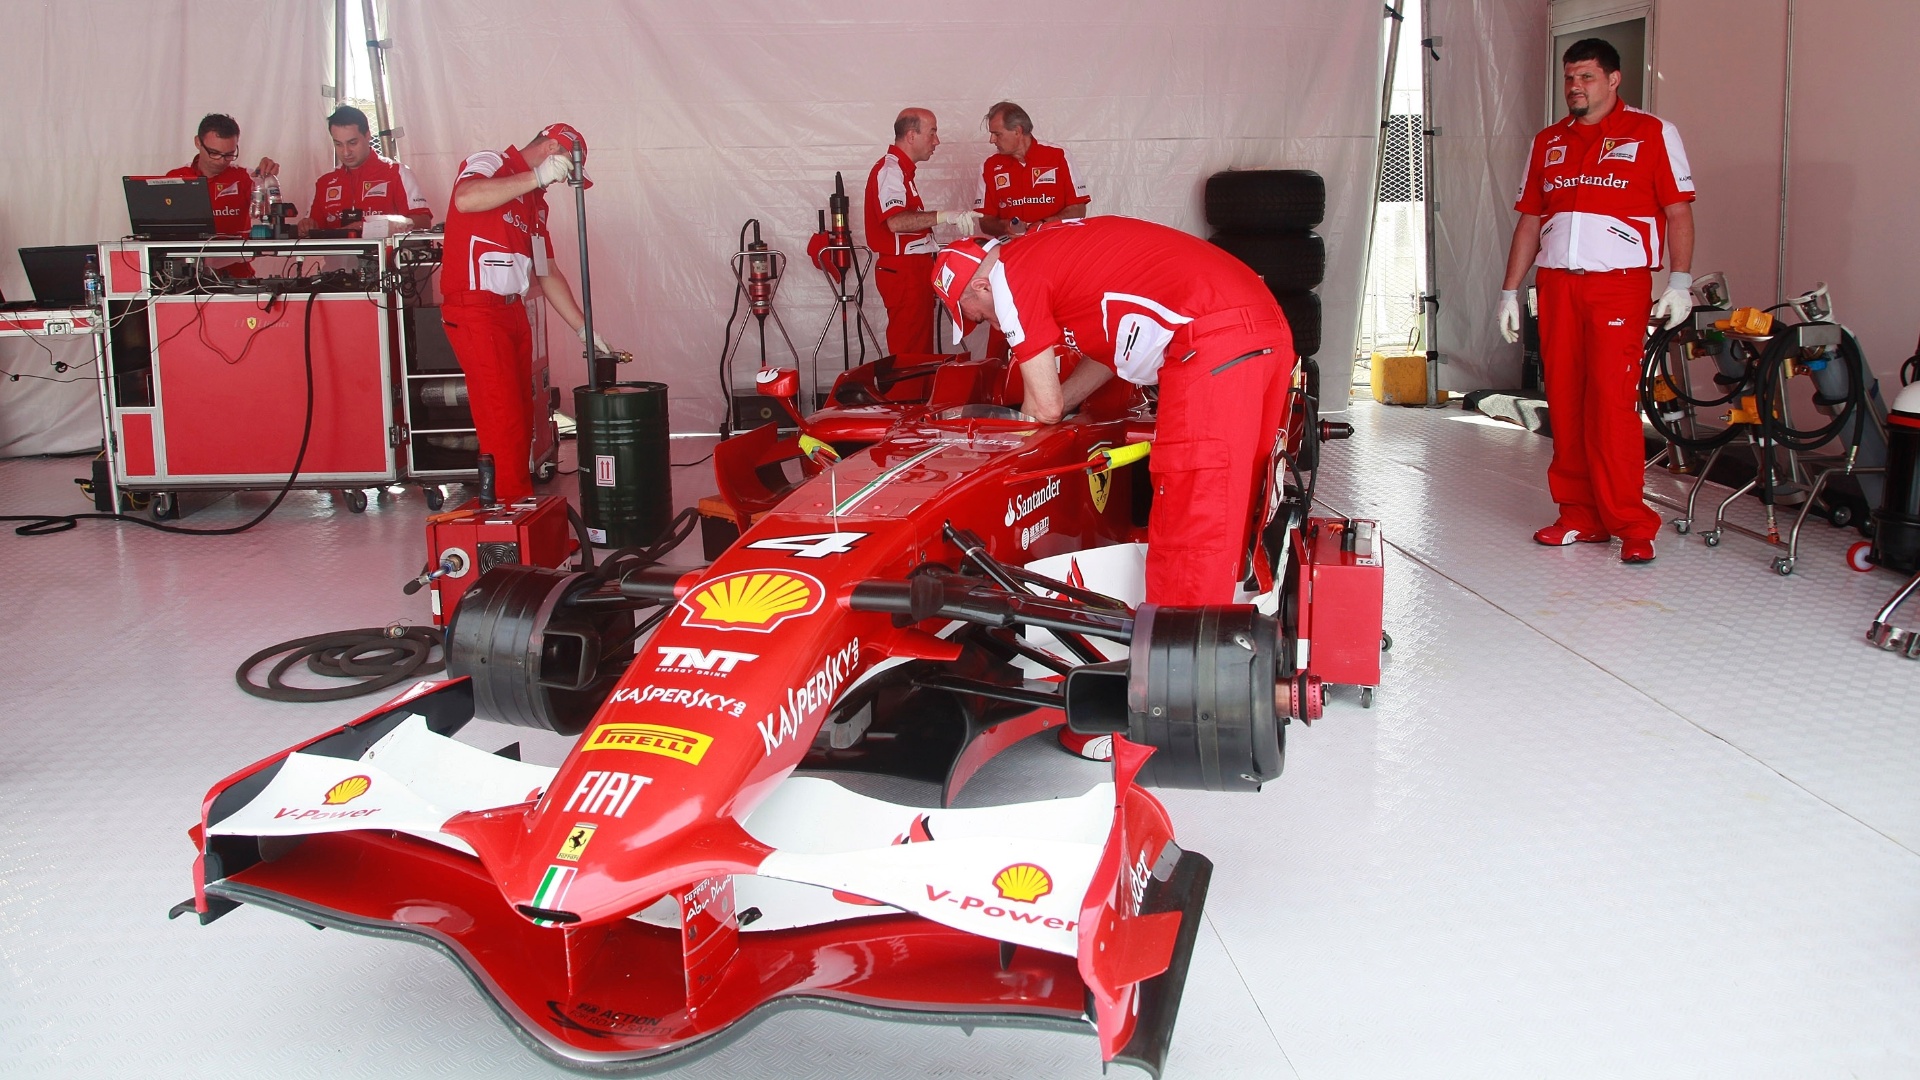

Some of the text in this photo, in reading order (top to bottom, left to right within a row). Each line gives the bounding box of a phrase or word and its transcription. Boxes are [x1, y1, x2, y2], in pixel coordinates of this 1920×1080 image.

[1554, 173, 1629, 190] Santander
[1006, 193, 1055, 207] Santander
[1015, 477, 1061, 521] Santander
[742, 531, 872, 559] 4
[654, 667, 728, 678] ENERGY DRINK
[657, 646, 760, 673] TNT
[609, 684, 736, 713] KASPERSKY
[756, 641, 852, 757] KASPERSKY
[593, 728, 699, 755] PIRELLI
[562, 770, 654, 819] FIAT
[273, 807, 382, 820] V-Power
[686, 898, 710, 923] Abu
[925, 884, 1079, 932] V-Power
[588, 1017, 625, 1030] ROAD
[599, 1010, 663, 1026] ACTION
